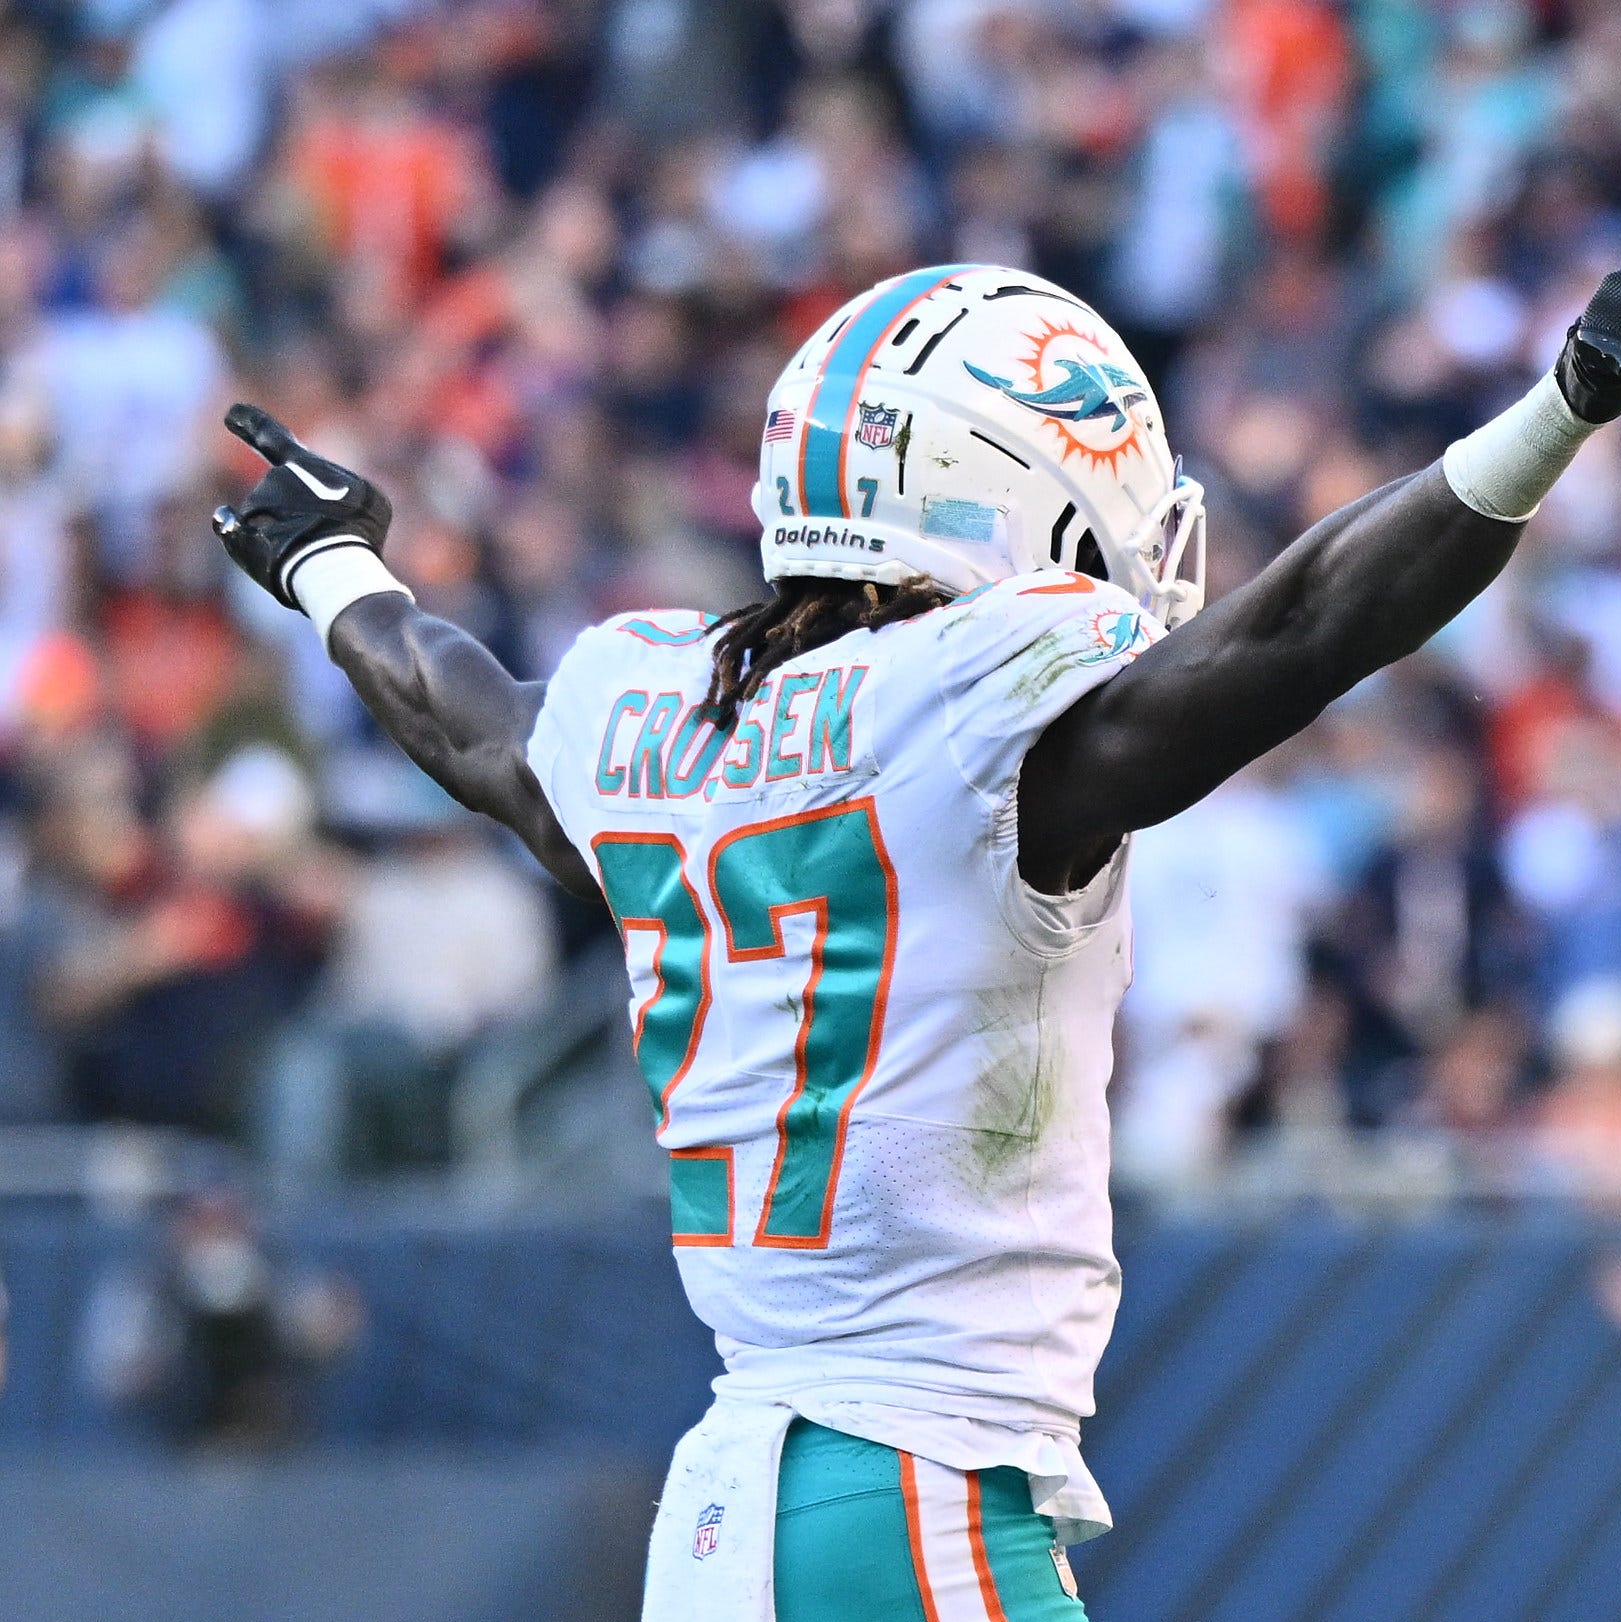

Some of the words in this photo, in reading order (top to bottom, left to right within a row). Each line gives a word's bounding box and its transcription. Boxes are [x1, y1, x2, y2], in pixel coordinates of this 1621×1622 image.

[861, 424, 890, 445] NFL
[775, 476, 795, 517] 2
[857, 477, 879, 518] 7
[775, 525, 886, 553] Dolphins
[594, 664, 870, 803] CROSEN
[590, 795, 899, 1251] 27
[694, 1526, 718, 1555] NFL
